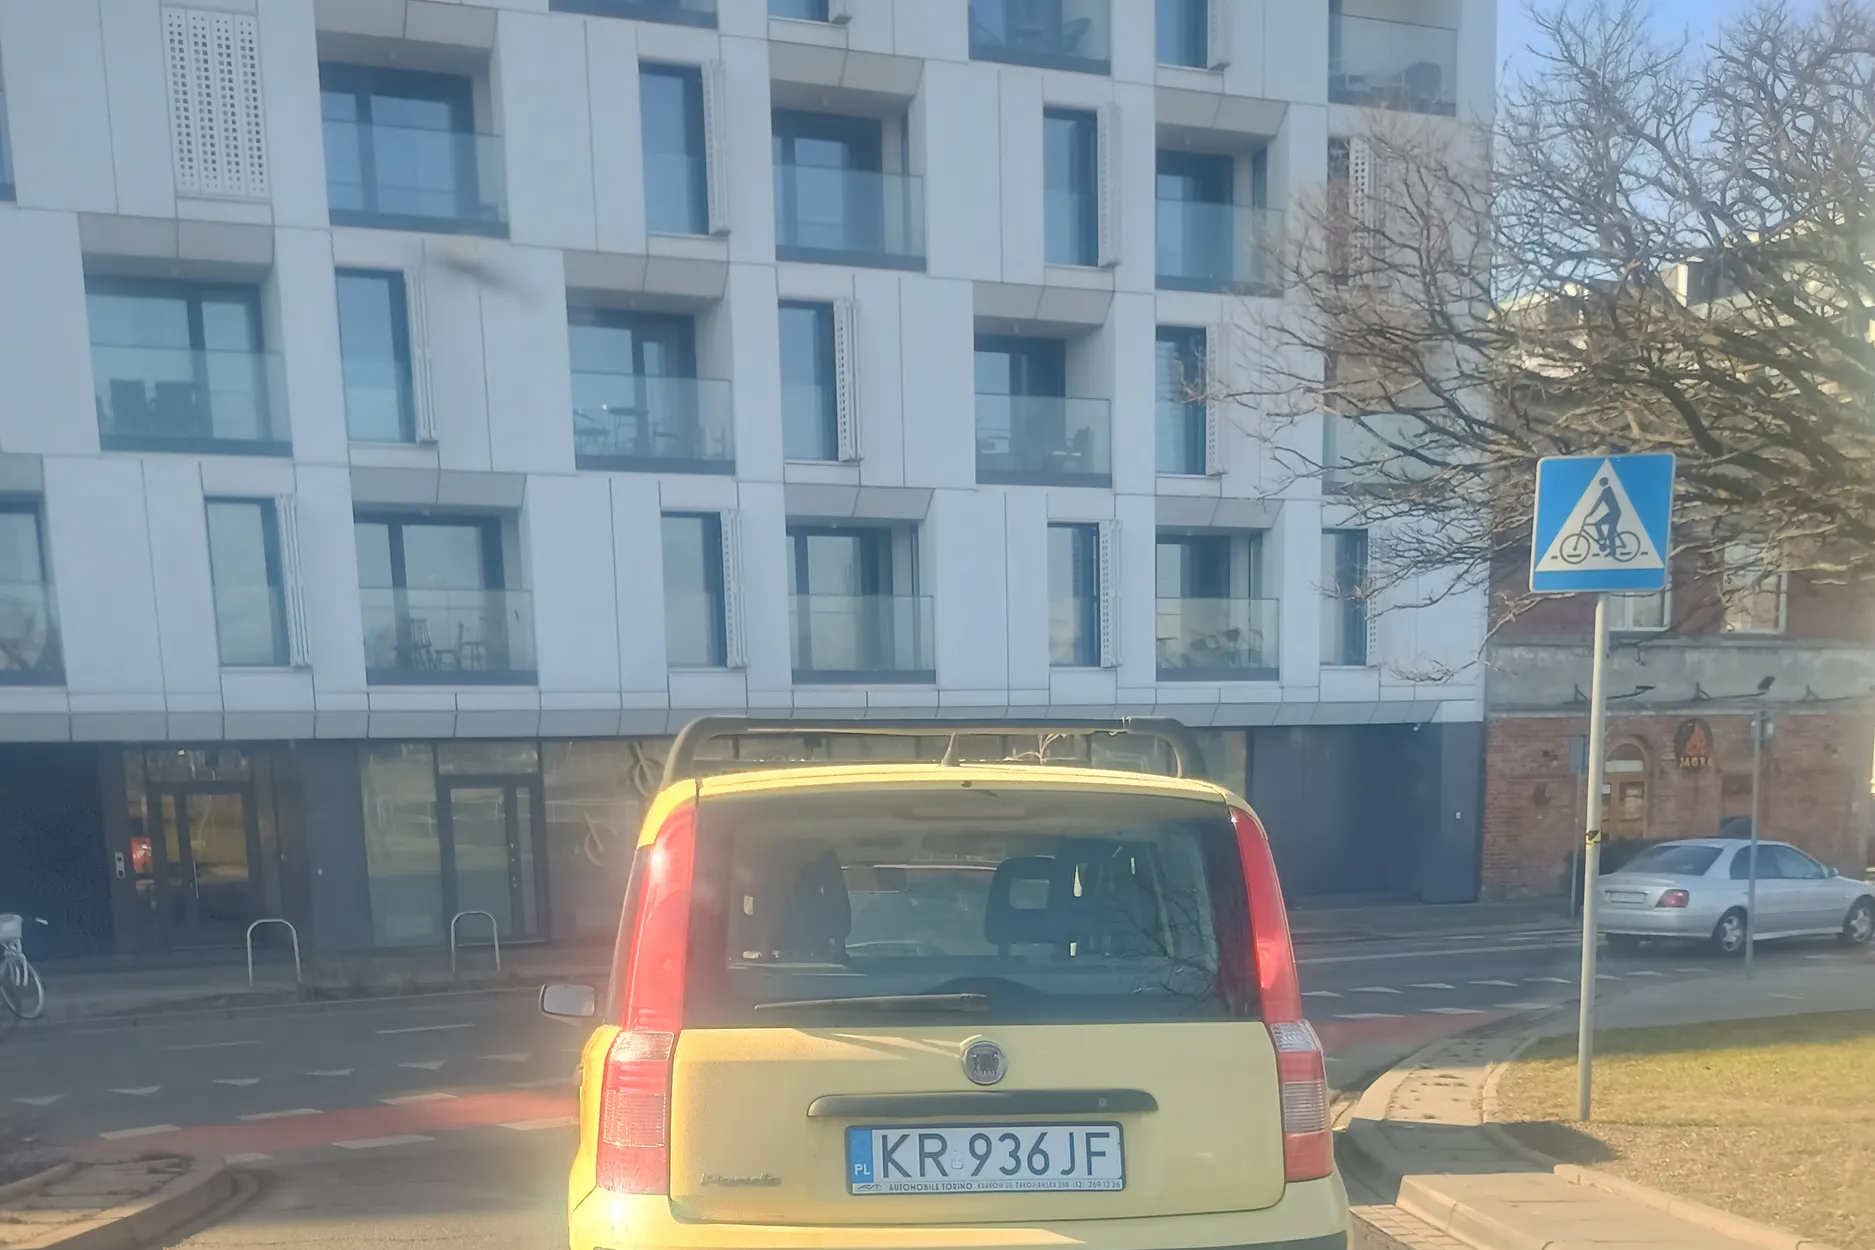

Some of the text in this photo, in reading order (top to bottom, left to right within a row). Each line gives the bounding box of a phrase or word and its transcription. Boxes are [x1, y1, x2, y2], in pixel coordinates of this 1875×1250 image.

[881, 1131, 1110, 1178] KR 936JF
[854, 1163, 871, 1176] PL
[888, 1183, 939, 1191] AUTOMOBILE
[941, 1182, 973, 1191] TORINO
[1088, 1180, 1101, 1189] 269
[1111, 1180, 1121, 1189] 26
